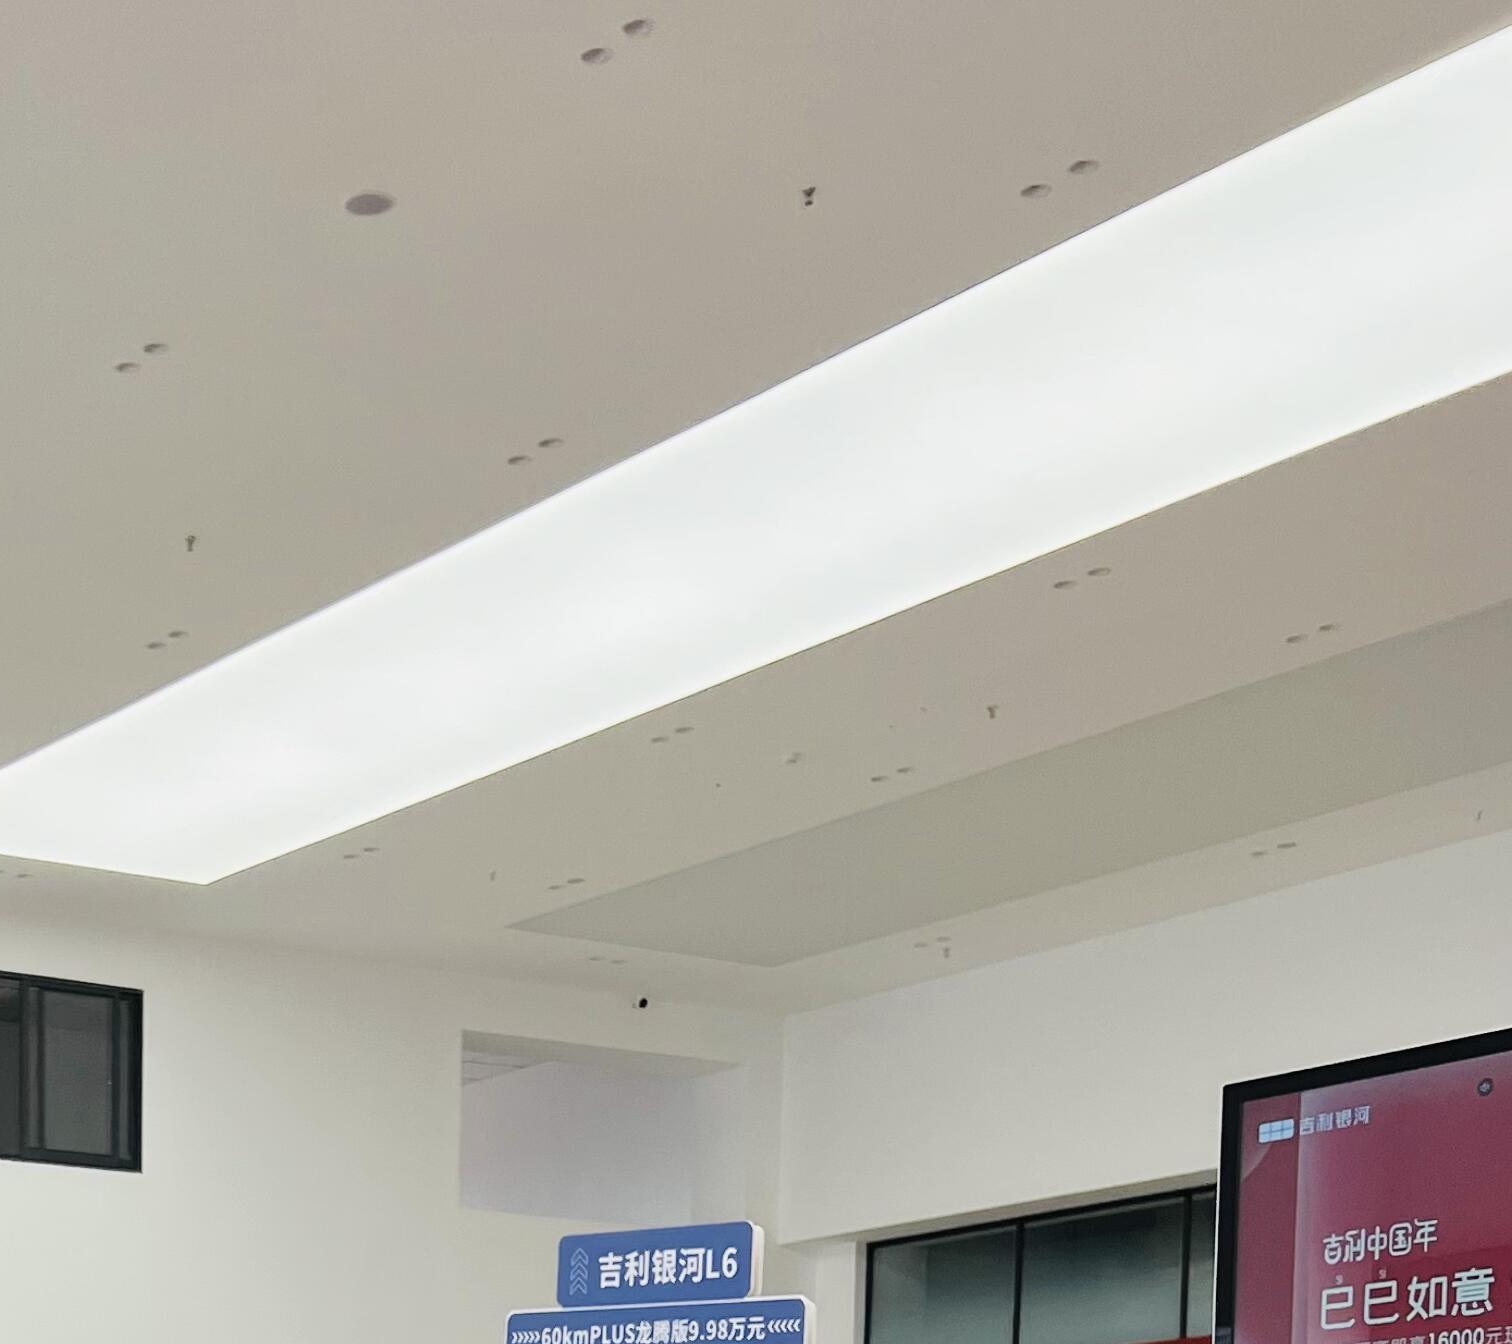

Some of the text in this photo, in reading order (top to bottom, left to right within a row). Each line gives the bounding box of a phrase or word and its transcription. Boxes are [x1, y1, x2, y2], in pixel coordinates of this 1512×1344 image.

[1299, 1105, 1371, 1136] 吉利银河
[1323, 1218, 1438, 1265] 吉利中国年
[599, 1245, 739, 1291] 吉利银河L6
